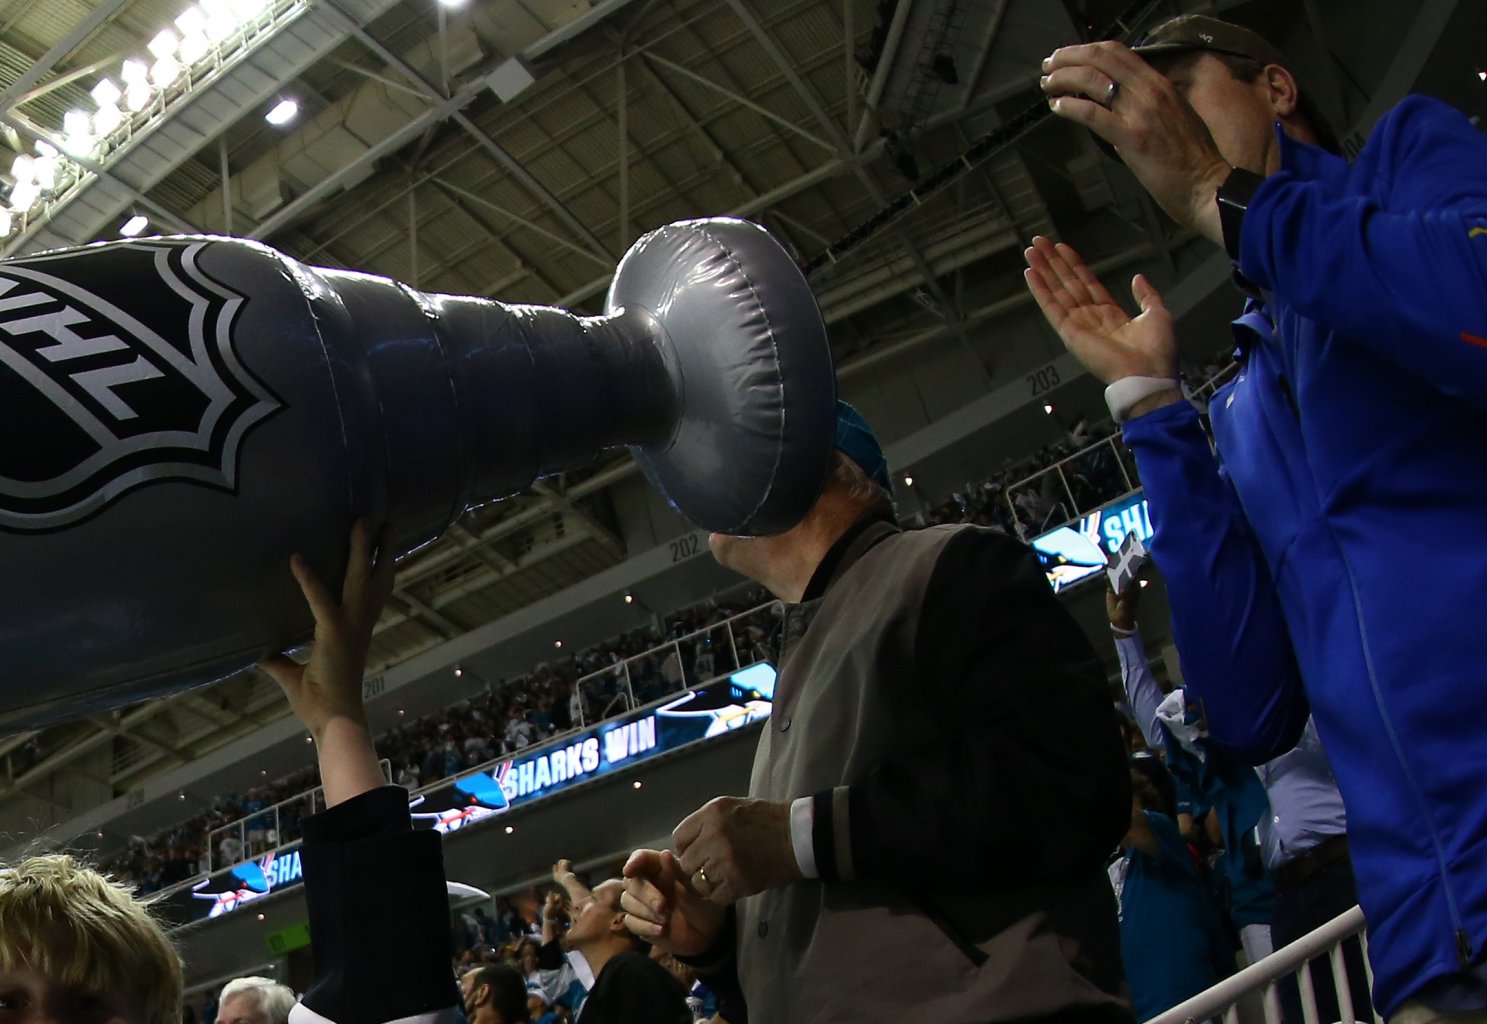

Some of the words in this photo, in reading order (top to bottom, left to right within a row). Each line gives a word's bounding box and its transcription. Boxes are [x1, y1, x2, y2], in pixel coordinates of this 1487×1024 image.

[1027, 364, 1060, 395] 203
[669, 534, 699, 562] 202
[505, 737, 600, 801] SHARKS
[604, 715, 657, 763] WIN
